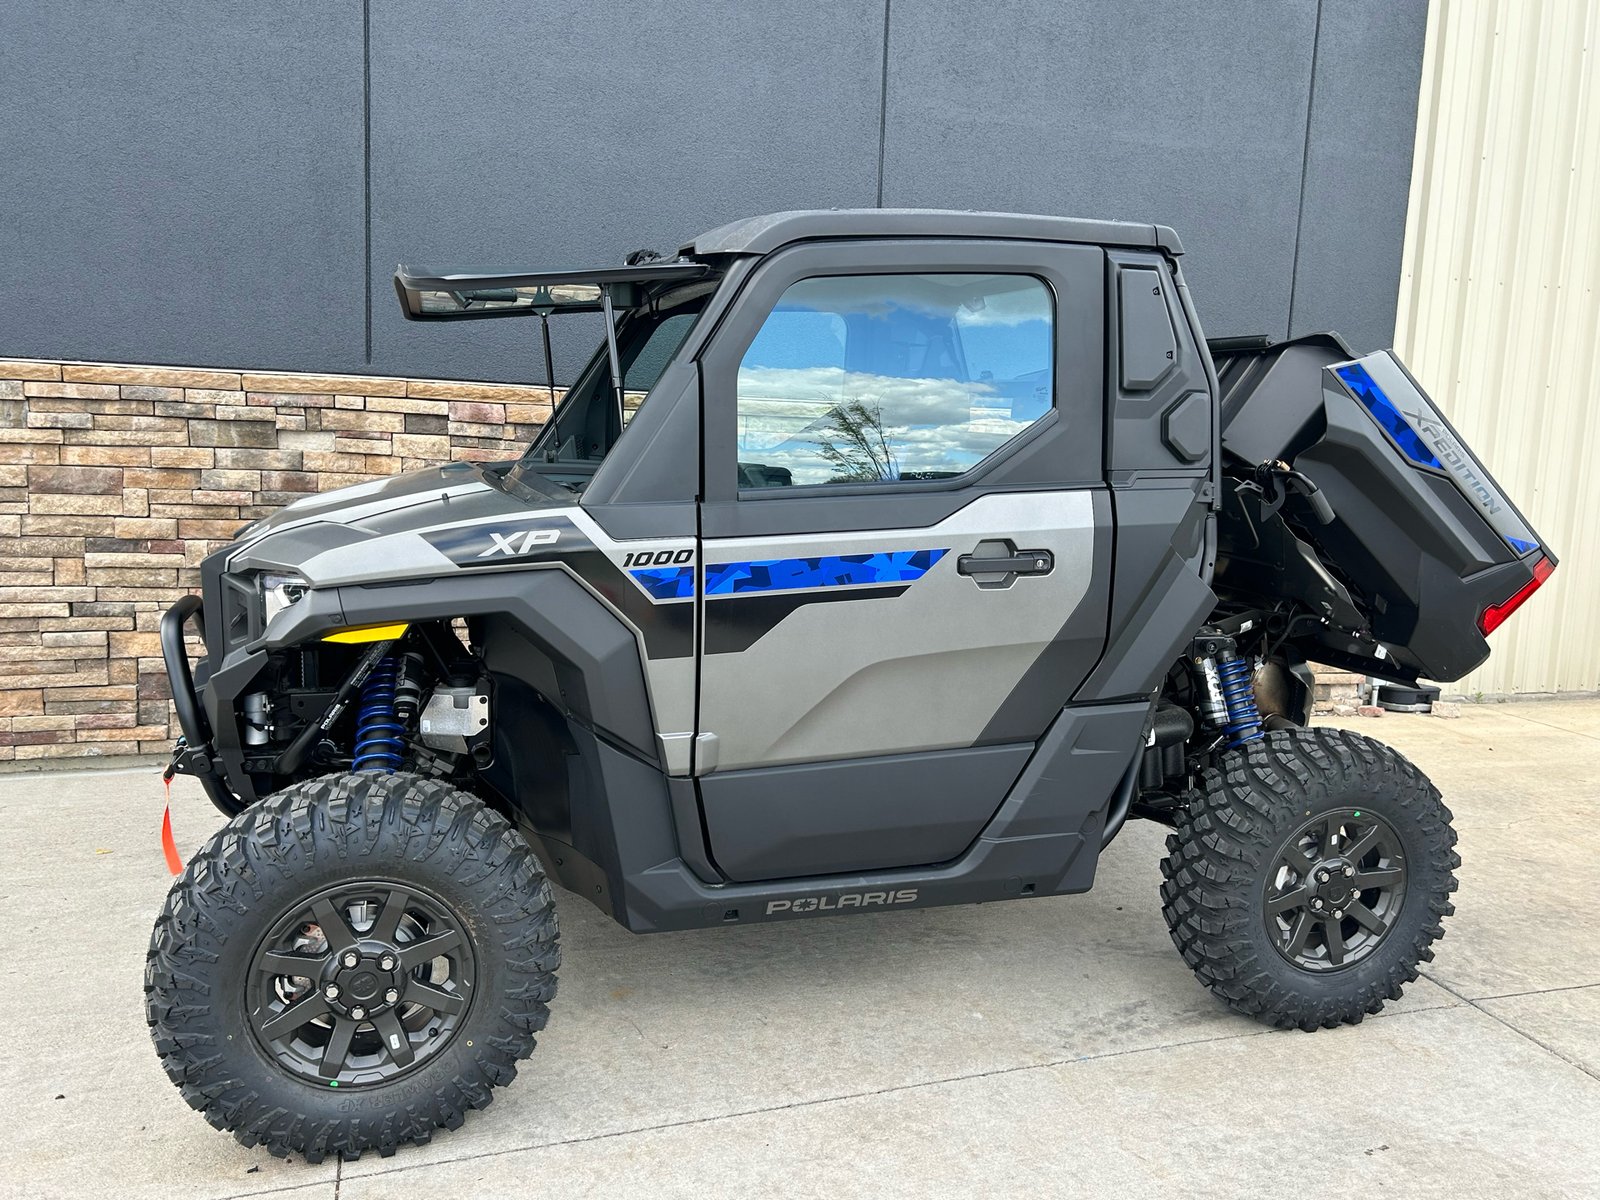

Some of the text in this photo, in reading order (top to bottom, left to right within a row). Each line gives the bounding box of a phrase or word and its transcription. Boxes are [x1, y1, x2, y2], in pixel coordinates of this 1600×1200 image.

[1401, 407, 1502, 515] XPEDITION
[477, 529, 562, 558] XP
[622, 549, 695, 568] 1000
[765, 888, 919, 916] POLARIS
